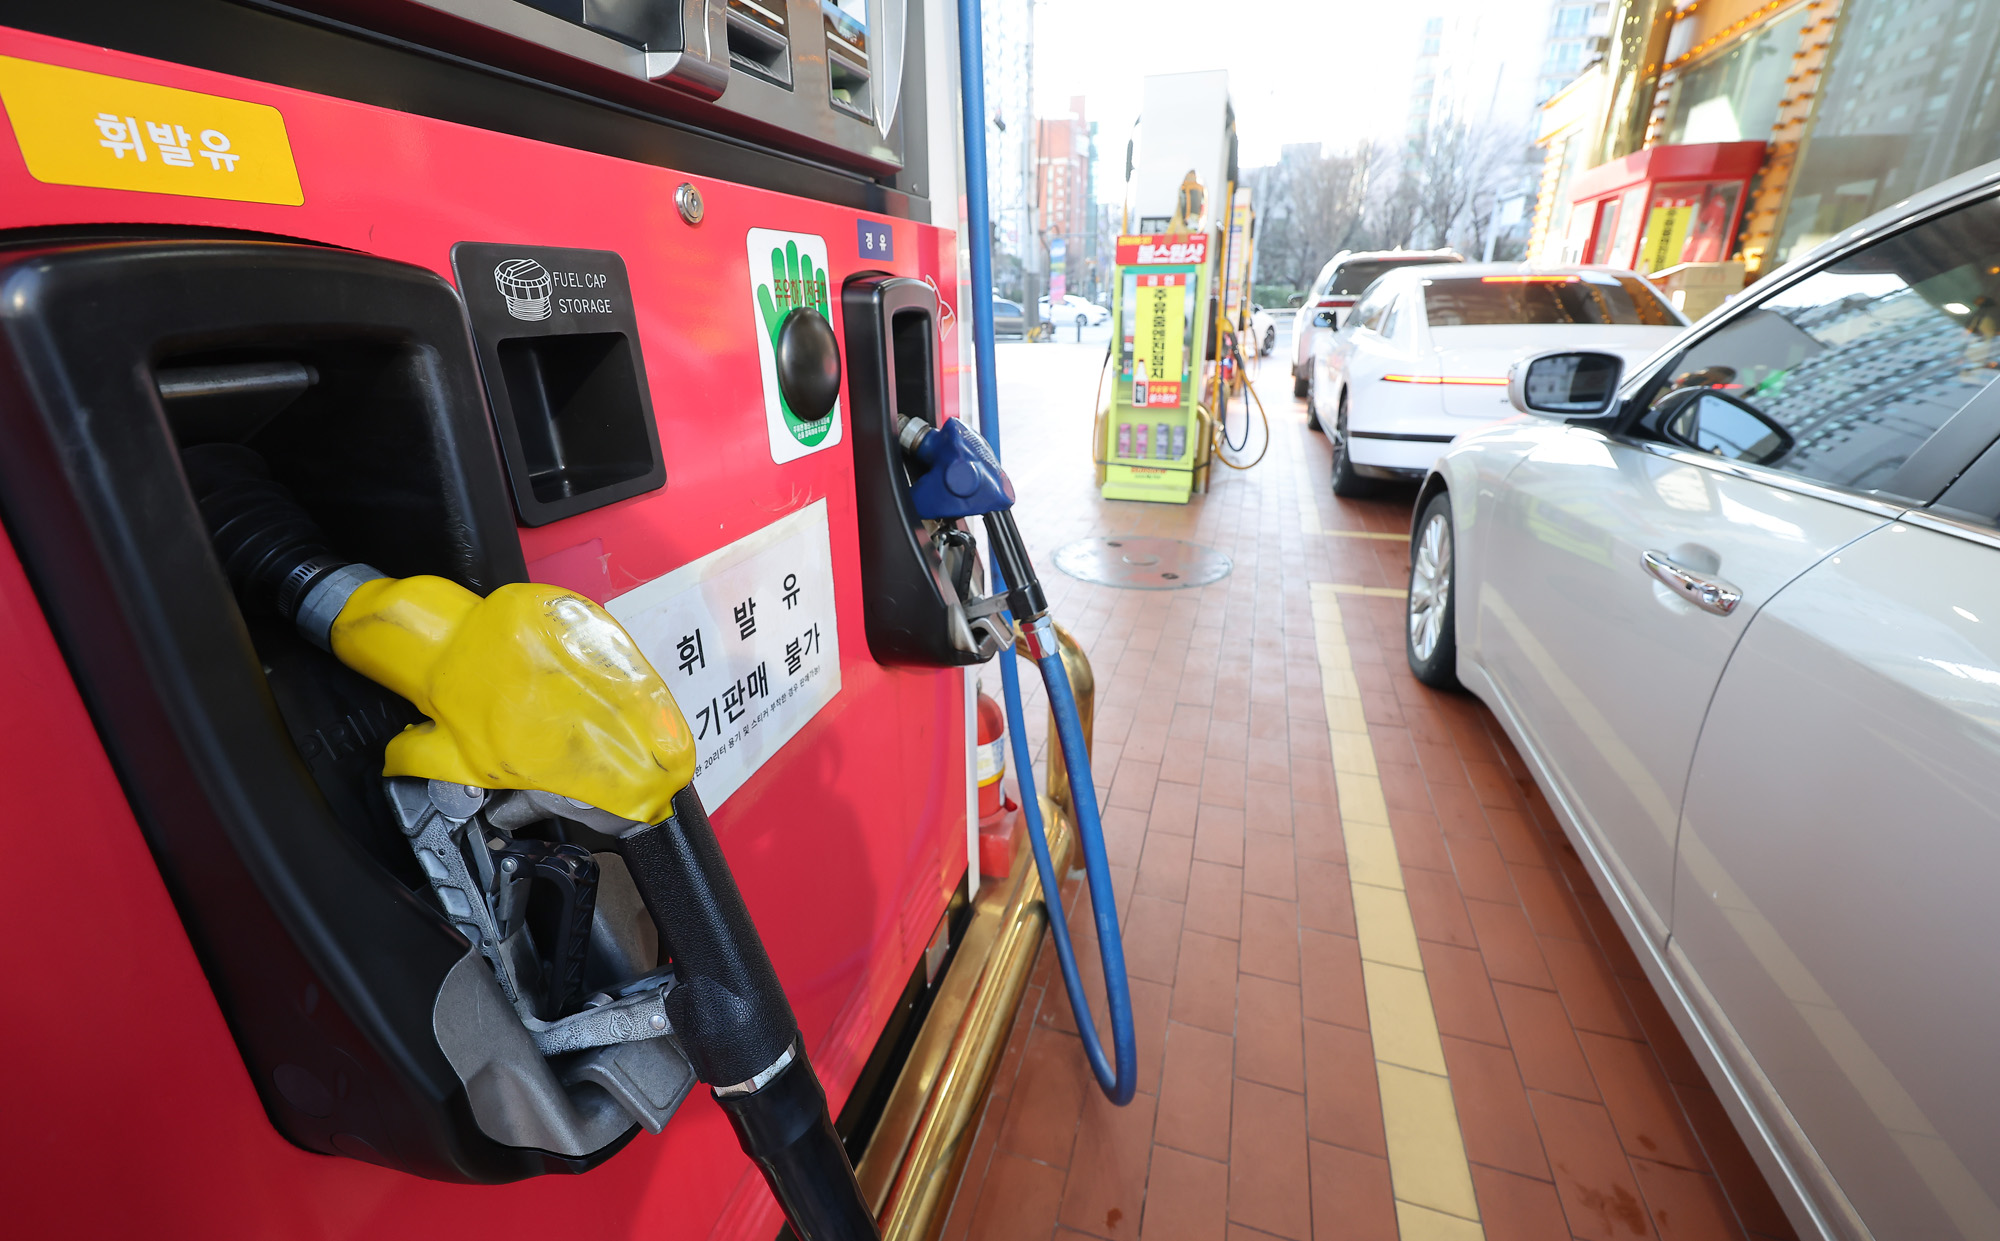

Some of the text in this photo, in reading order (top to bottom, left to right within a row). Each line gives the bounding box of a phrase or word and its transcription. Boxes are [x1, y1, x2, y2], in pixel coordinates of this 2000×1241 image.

[94, 112, 241, 172] 휘발유
[553, 271, 607, 289] FUEL CAP
[558, 298, 613, 314] STORAGE
[695, 622, 821, 741] 기판매 불가
[704, 743, 727, 770] 20리터
[728, 731, 742, 749] 용기
[751, 708, 769, 729] 스티커
